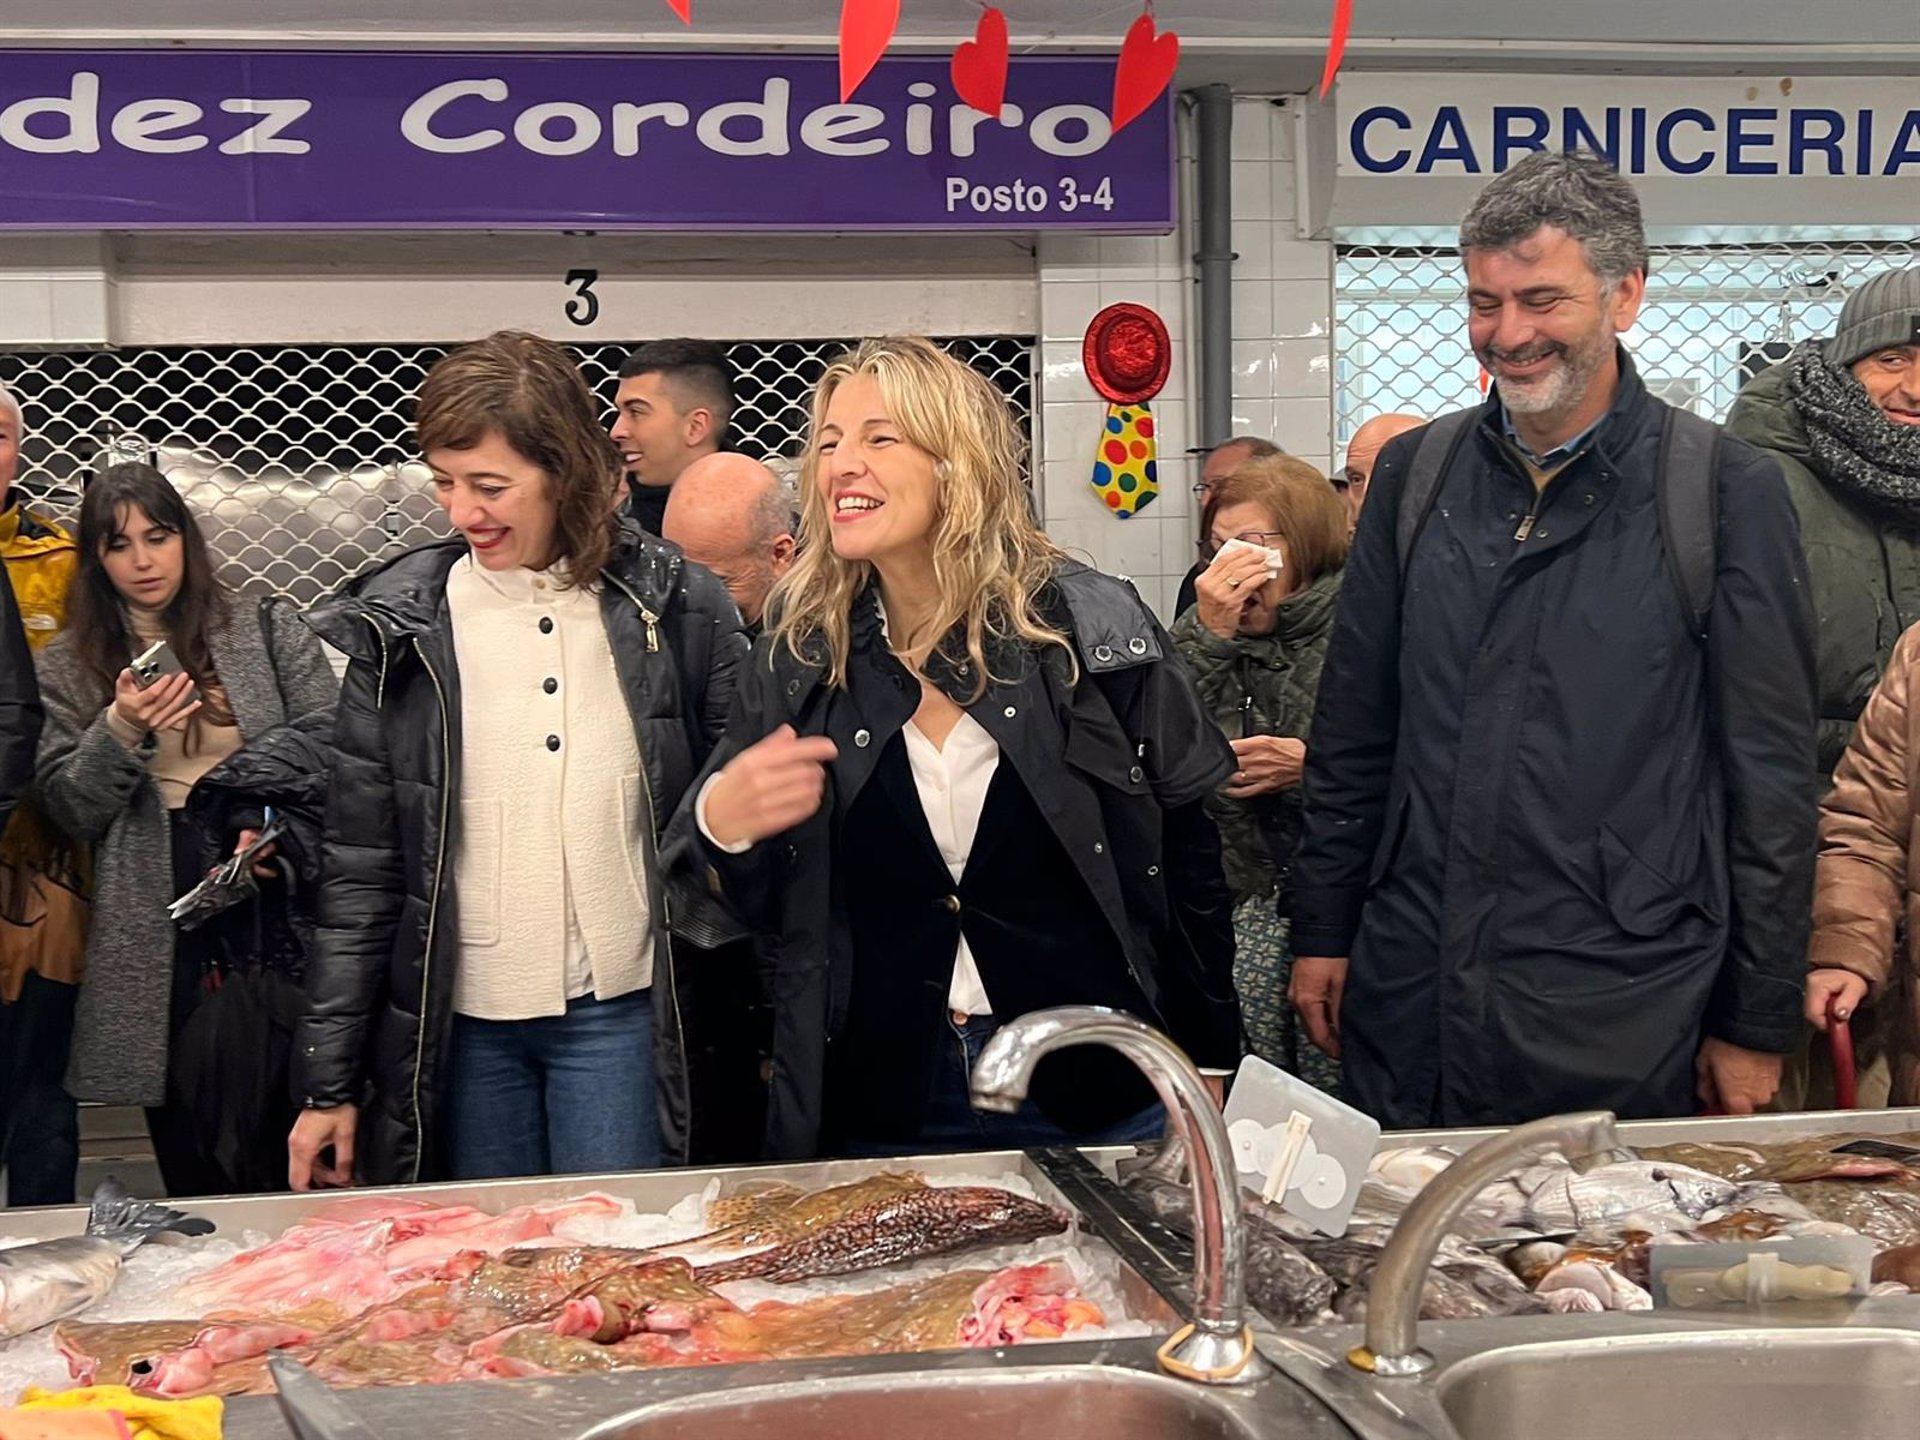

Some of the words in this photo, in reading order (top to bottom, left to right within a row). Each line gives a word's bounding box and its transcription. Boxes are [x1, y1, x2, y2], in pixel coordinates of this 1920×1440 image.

[0, 71, 312, 154] dez
[401, 76, 1112, 157] Cordeiro
[1349, 105, 1920, 176] CARNICERIA
[946, 177, 1048, 212] Posto
[1058, 177, 1115, 212] 3-4
[564, 268, 599, 326] 3
